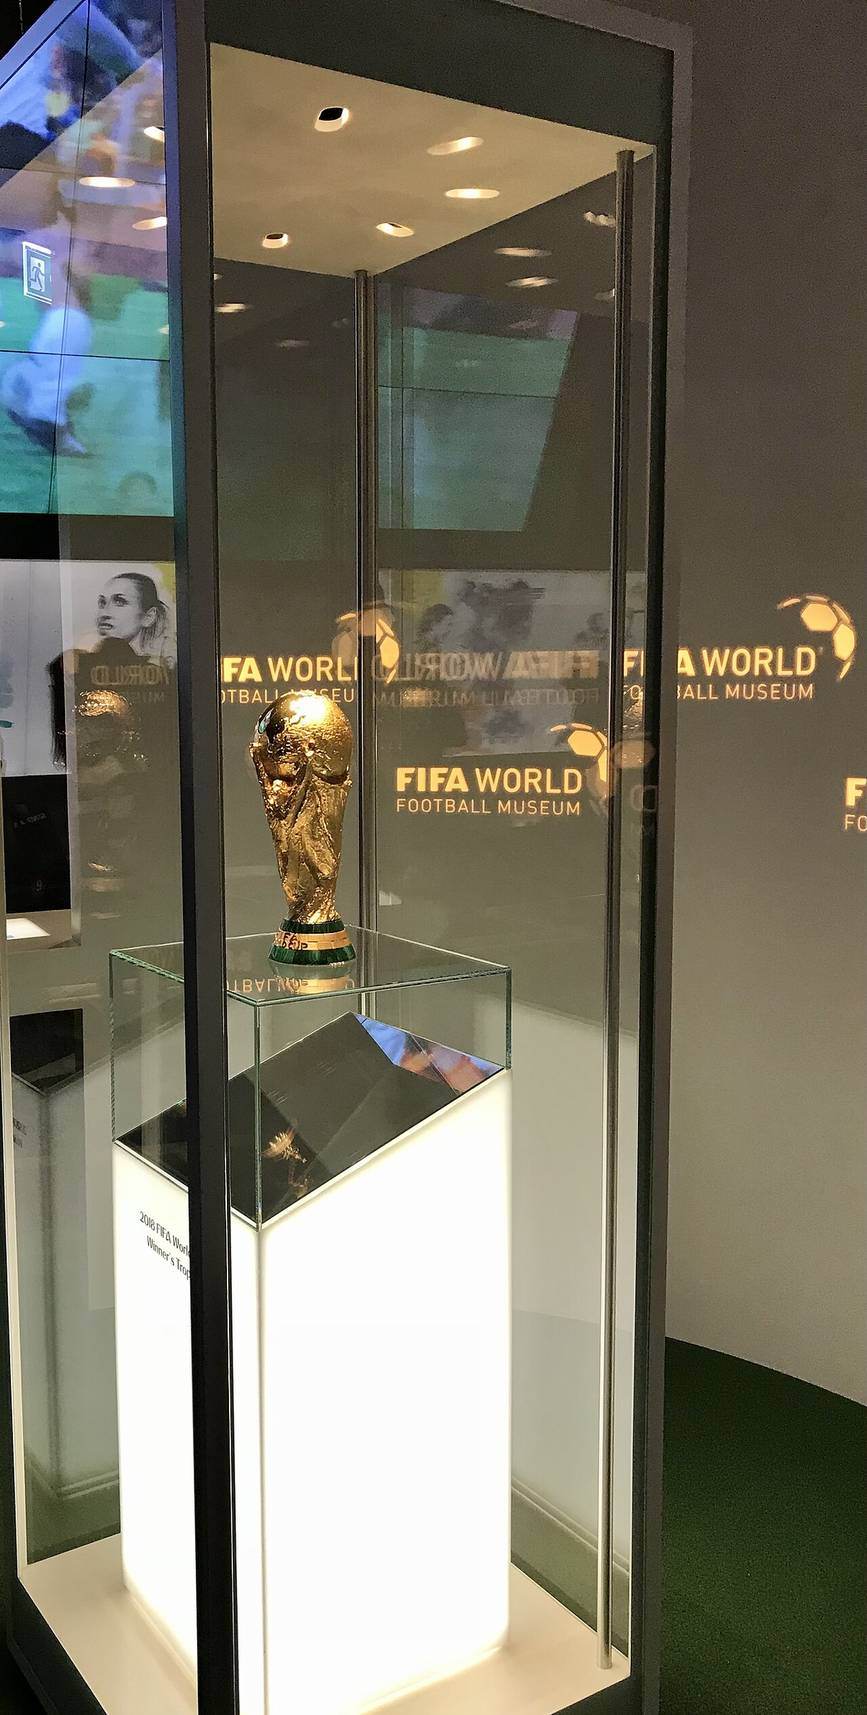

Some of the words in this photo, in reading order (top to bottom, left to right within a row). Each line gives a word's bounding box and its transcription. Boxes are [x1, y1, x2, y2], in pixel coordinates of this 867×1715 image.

[221, 657, 262, 682] FA
[267, 656, 358, 681] WORL
[702, 647, 816, 676] WORLD
[726, 684, 814, 700] MUSEUM
[396, 767, 469, 792] FIFA
[475, 768, 582, 793] WORLD
[396, 798, 491, 813] FOOTBALL
[498, 800, 580, 815] MUSEUM
[139, 1210, 156, 1231] 2018
[156, 1222, 172, 1244] FIFA
[146, 1235, 175, 1267] Winner's
